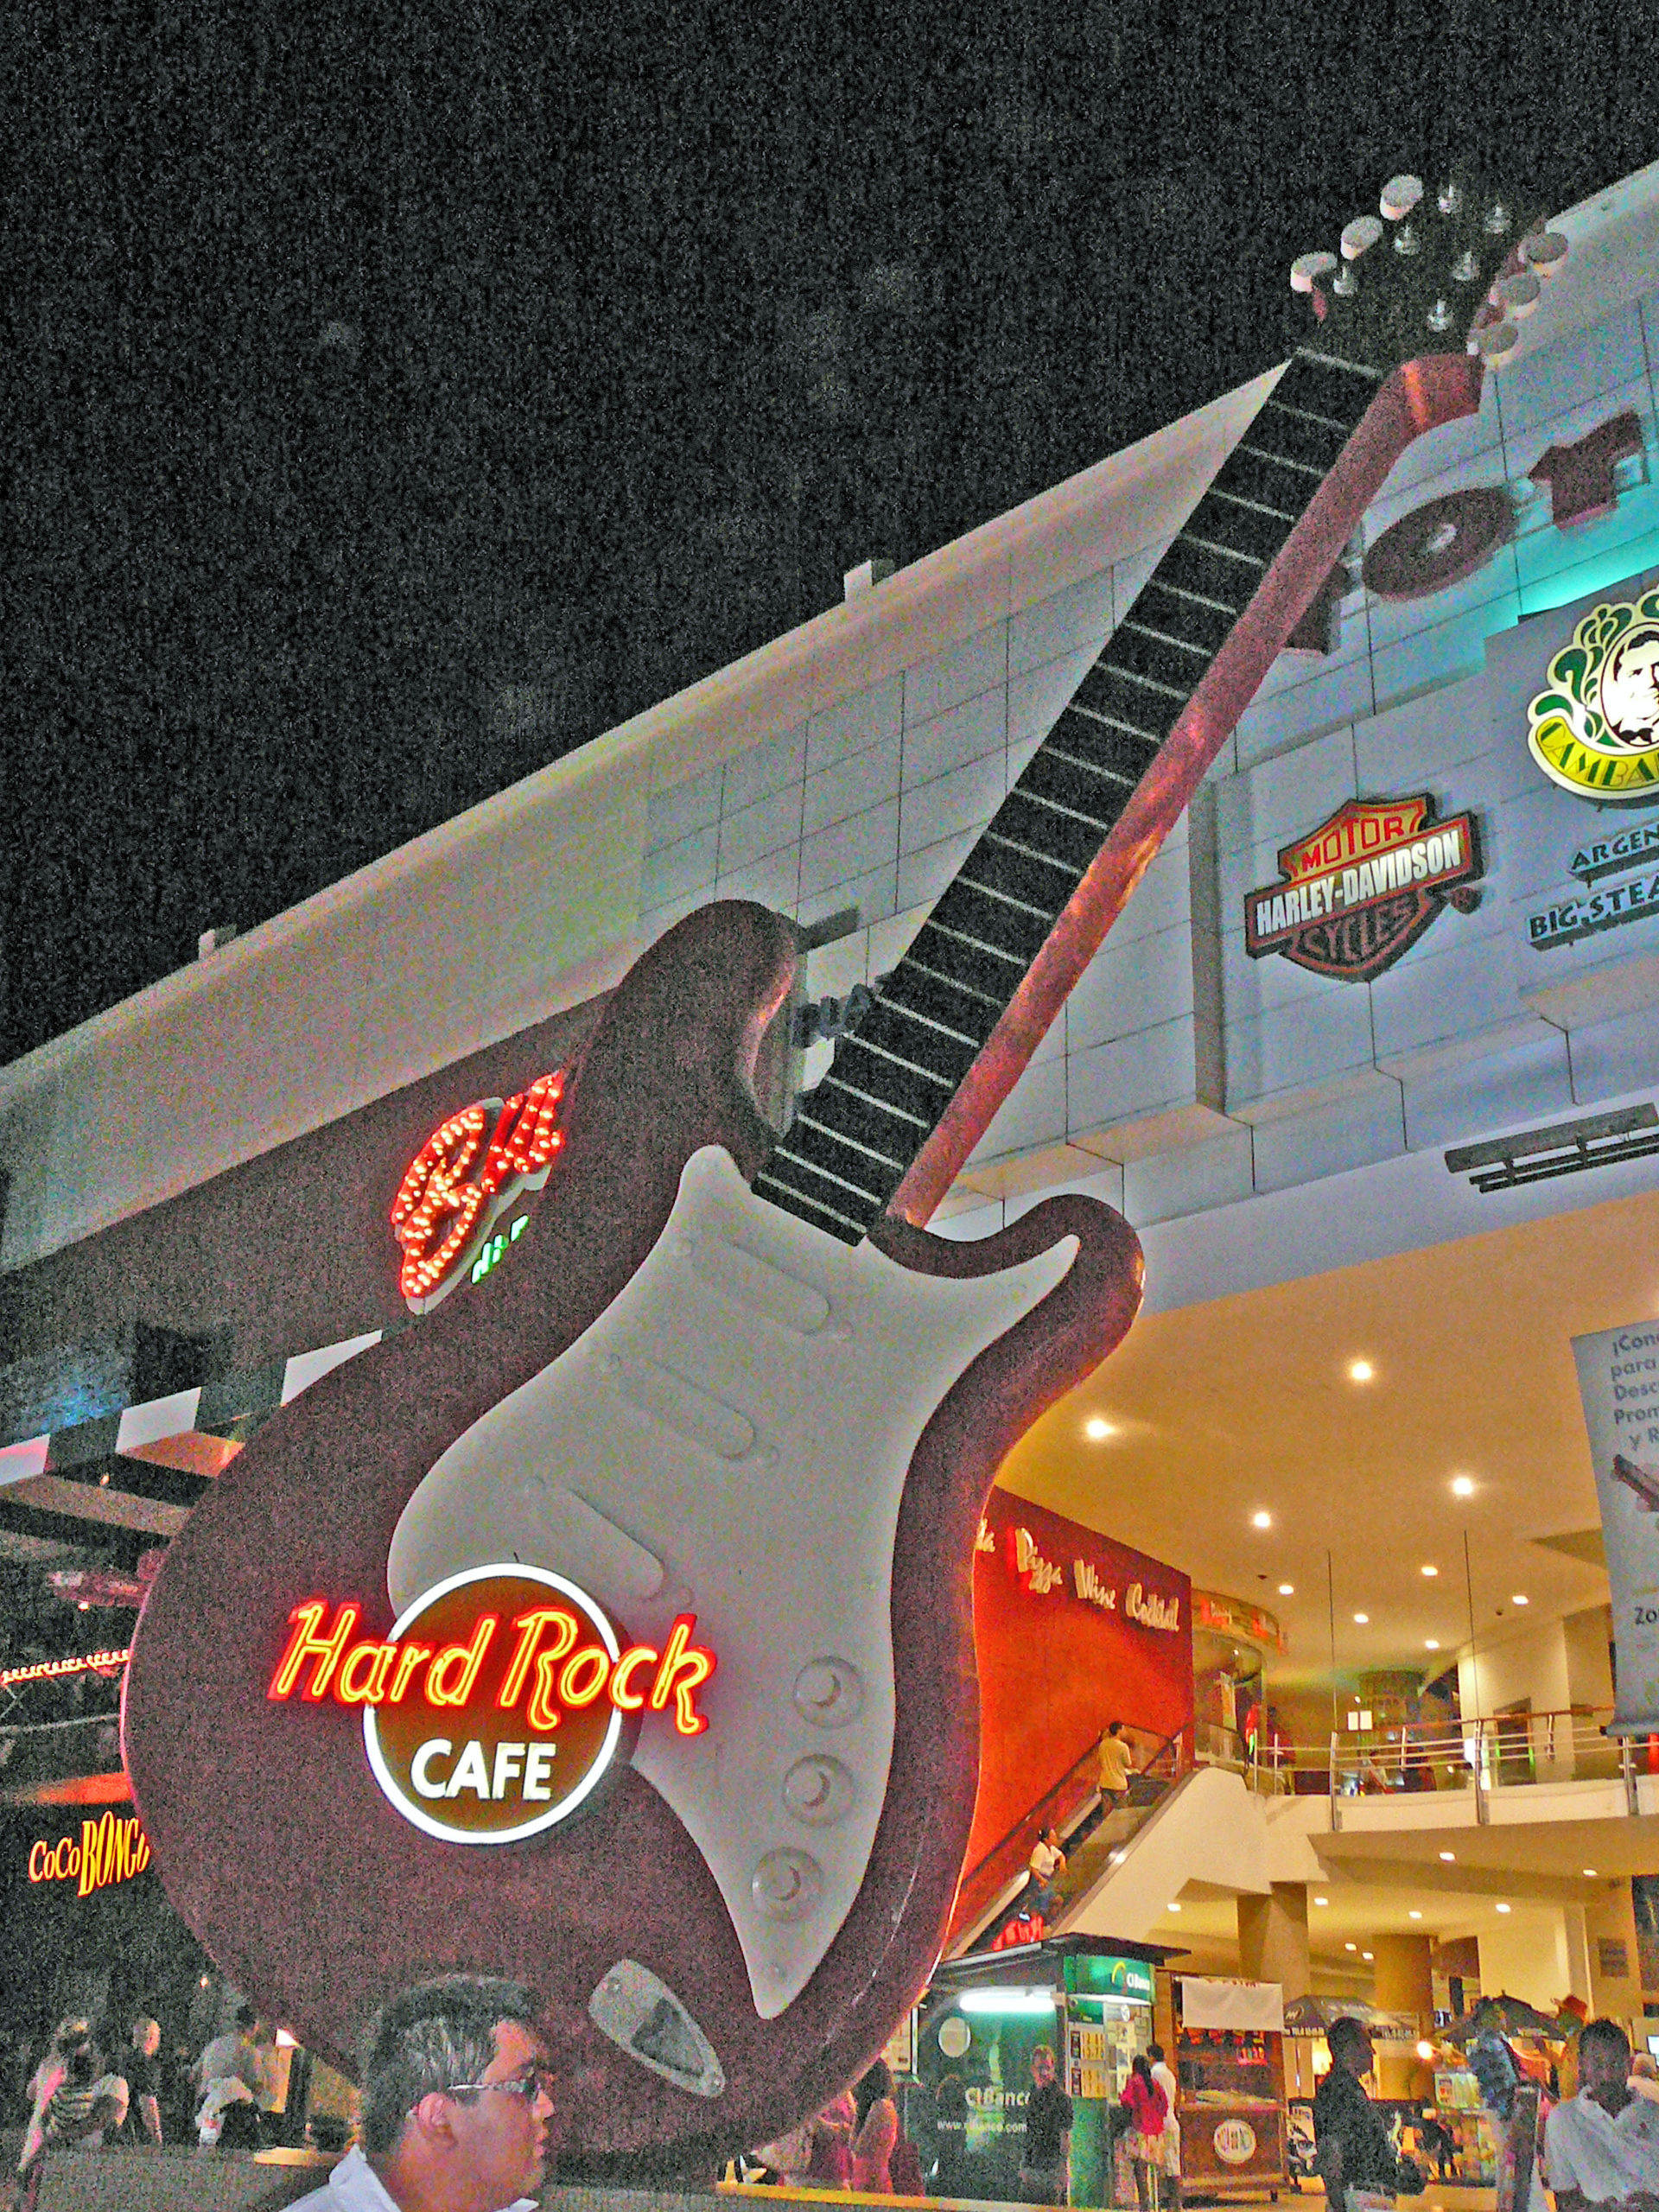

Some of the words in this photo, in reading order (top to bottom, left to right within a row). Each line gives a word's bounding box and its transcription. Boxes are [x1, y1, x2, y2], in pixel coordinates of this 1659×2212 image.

[1539, 721, 1659, 787] CAMBA
[1301, 817, 1406, 872] MOTOR
[1256, 830, 1461, 937] HARLEY-DAVIDSON
[1304, 899, 1412, 961] CYCLES
[1611, 1358, 1656, 1382] para
[1074, 1559, 1116, 1610] Wine
[268, 1600, 500, 1707] Hard
[499, 1605, 717, 1735] Rock
[410, 1738, 556, 1802] CAFE
